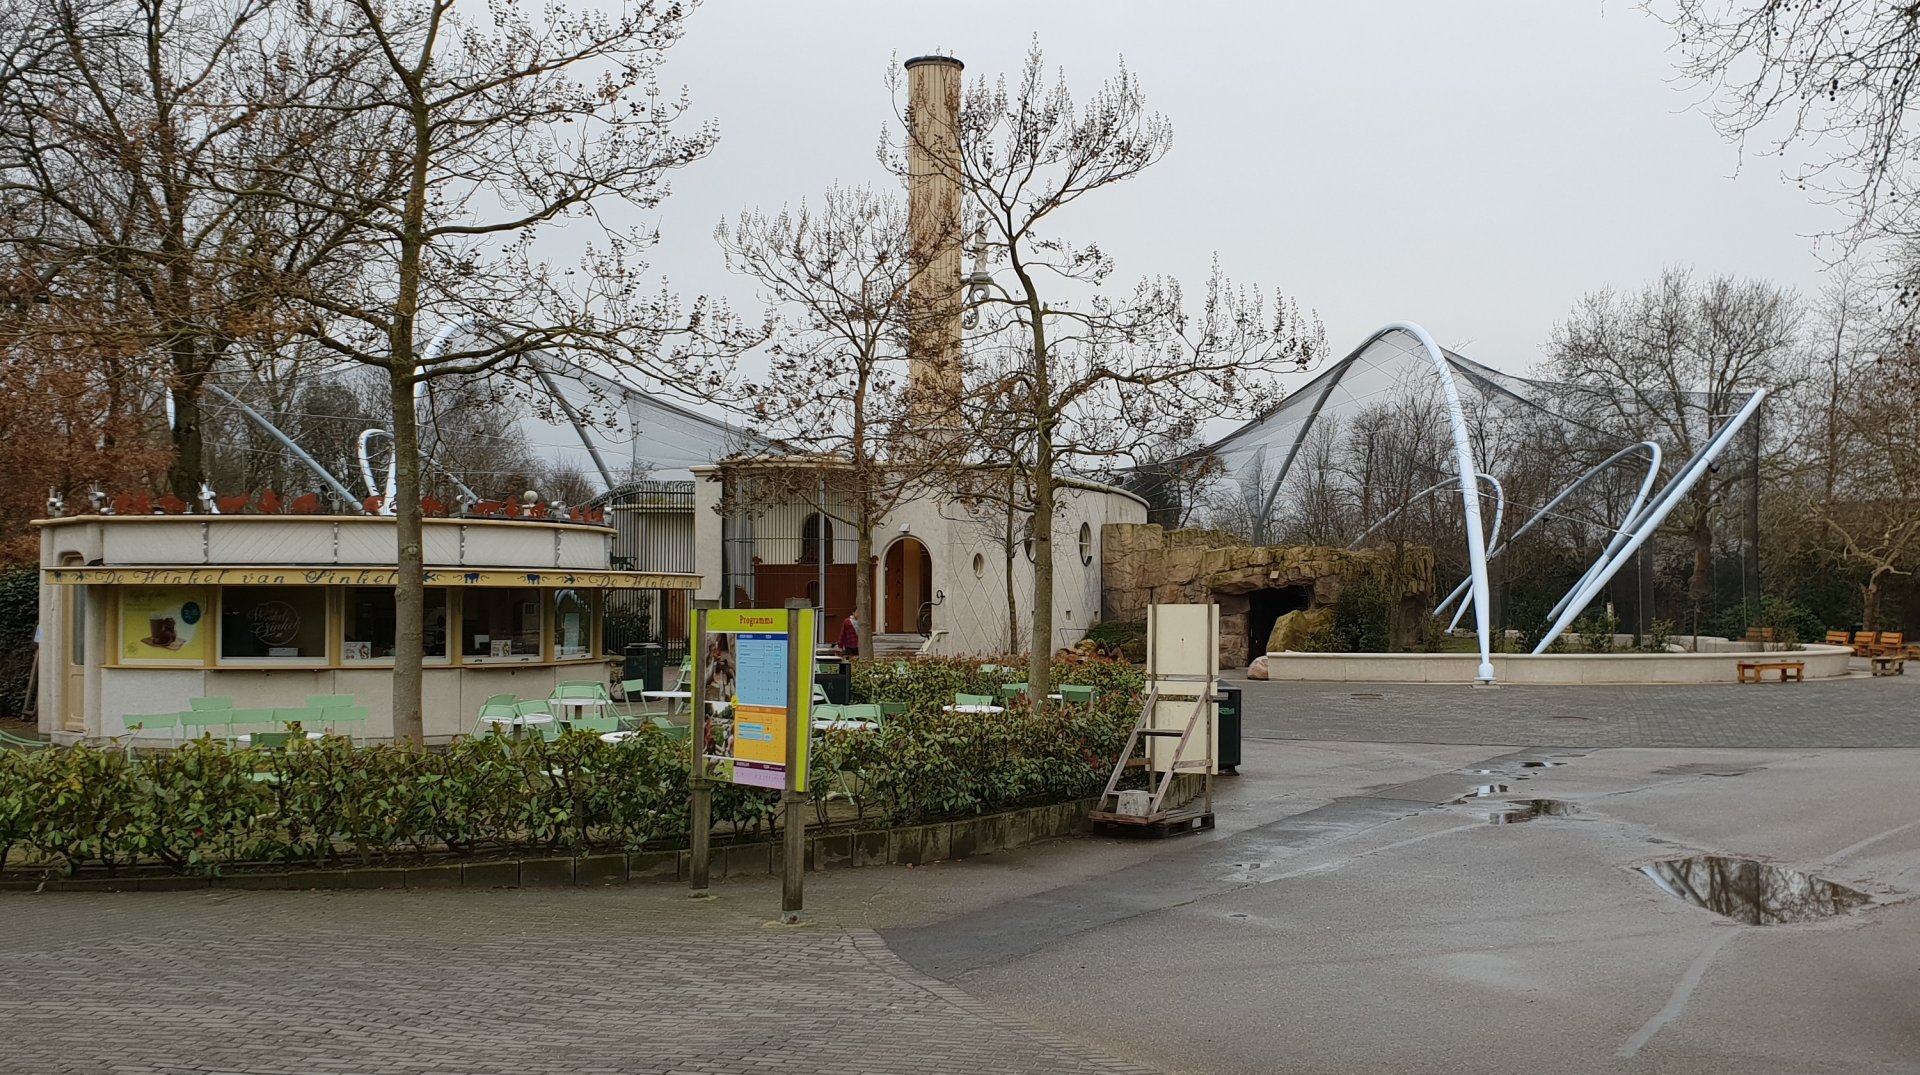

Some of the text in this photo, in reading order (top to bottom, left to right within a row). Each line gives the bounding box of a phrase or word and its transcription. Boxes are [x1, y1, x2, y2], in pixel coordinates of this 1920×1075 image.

[94, 568, 399, 585] De Winkel van Sinkel
[739, 615, 774, 627] Programma
